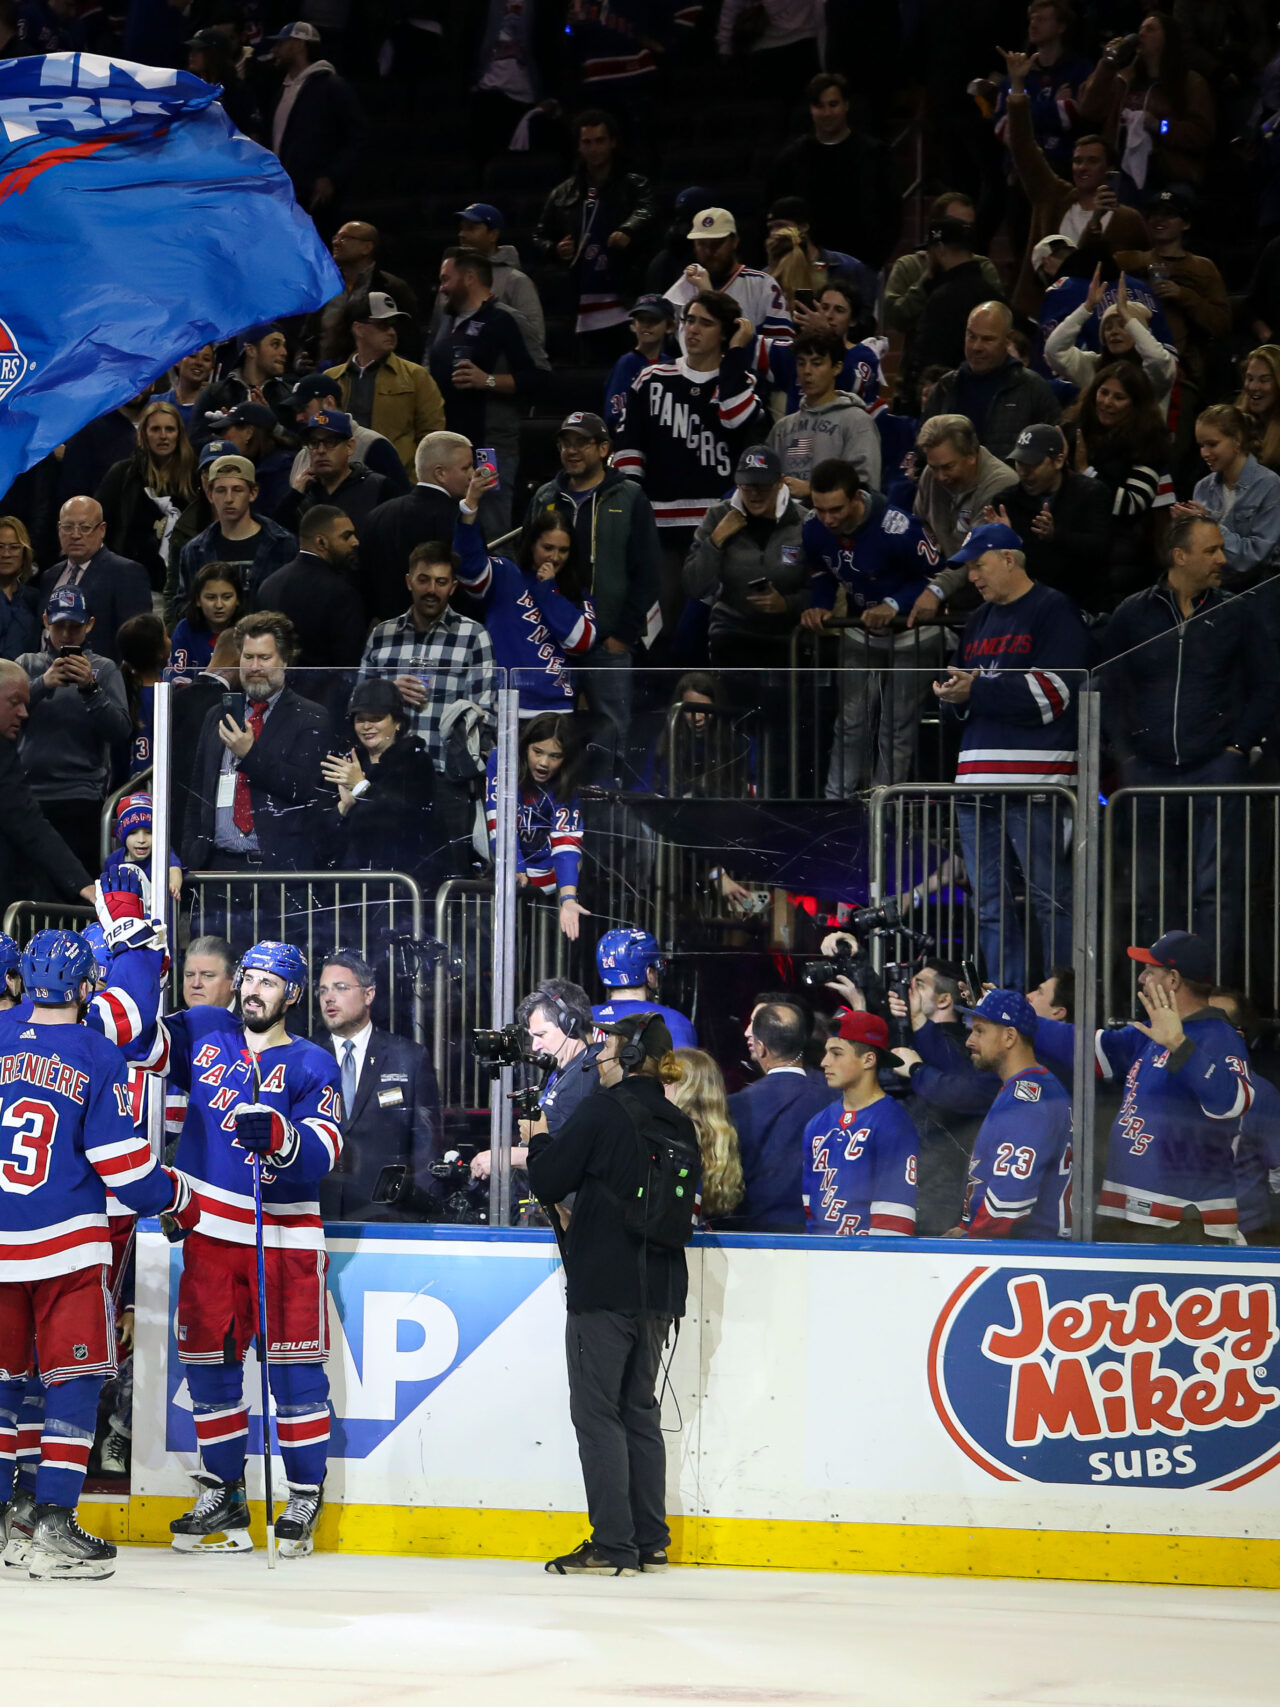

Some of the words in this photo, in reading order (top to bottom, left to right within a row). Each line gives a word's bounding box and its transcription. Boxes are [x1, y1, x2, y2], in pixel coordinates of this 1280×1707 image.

[40, 52, 177, 89] IN
[261, 1064, 287, 1093] A
[316, 1085, 342, 1124] 20
[843, 1128, 871, 1161] C
[993, 1142, 1037, 1179] 23
[983, 1275, 1279, 1365] Jersey
[1008, 1350, 1278, 1445] Mike's
[1088, 1445, 1198, 1482] SUBS
